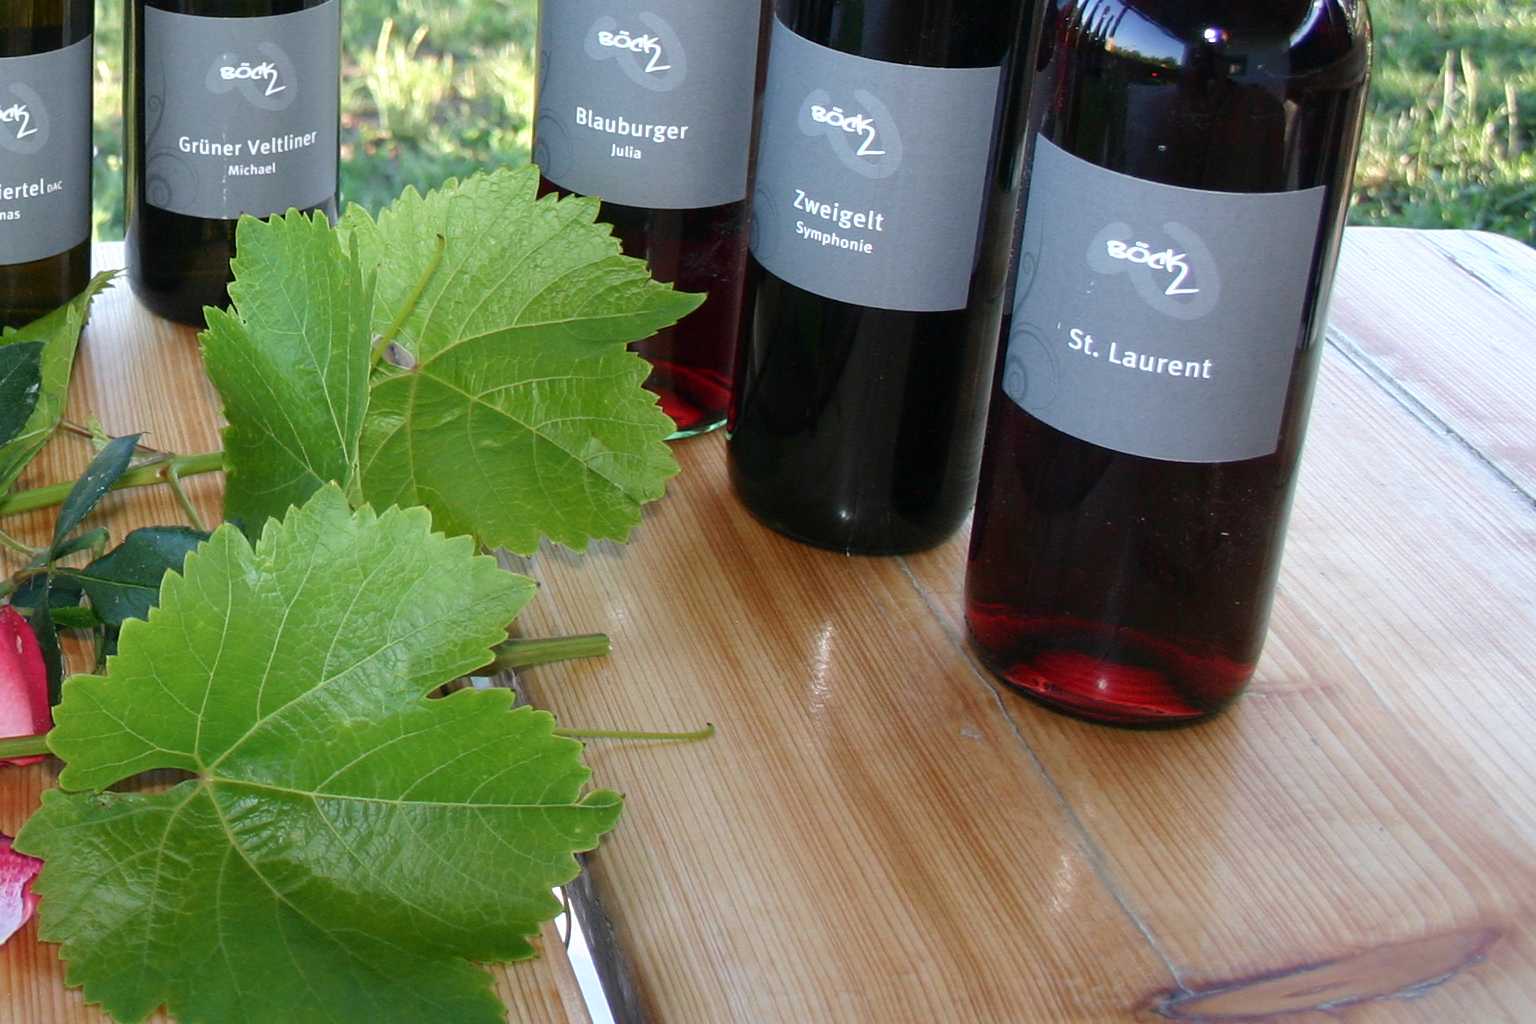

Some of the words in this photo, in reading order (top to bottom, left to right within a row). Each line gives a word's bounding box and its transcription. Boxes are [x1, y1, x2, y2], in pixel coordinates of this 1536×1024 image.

[575, 106, 689, 143] Blauburger
[178, 136, 242, 156] Grüner
[247, 130, 317, 155] Veltliner
[611, 143, 642, 160] Julia
[228, 162, 276, 176] Michael
[47, 180, 63, 193] DAC
[792, 189, 884, 232] Zweigelt
[795, 220, 873, 254] Symphonie
[1067, 328, 1099, 358] St.
[1108, 341, 1213, 380] Laurent
